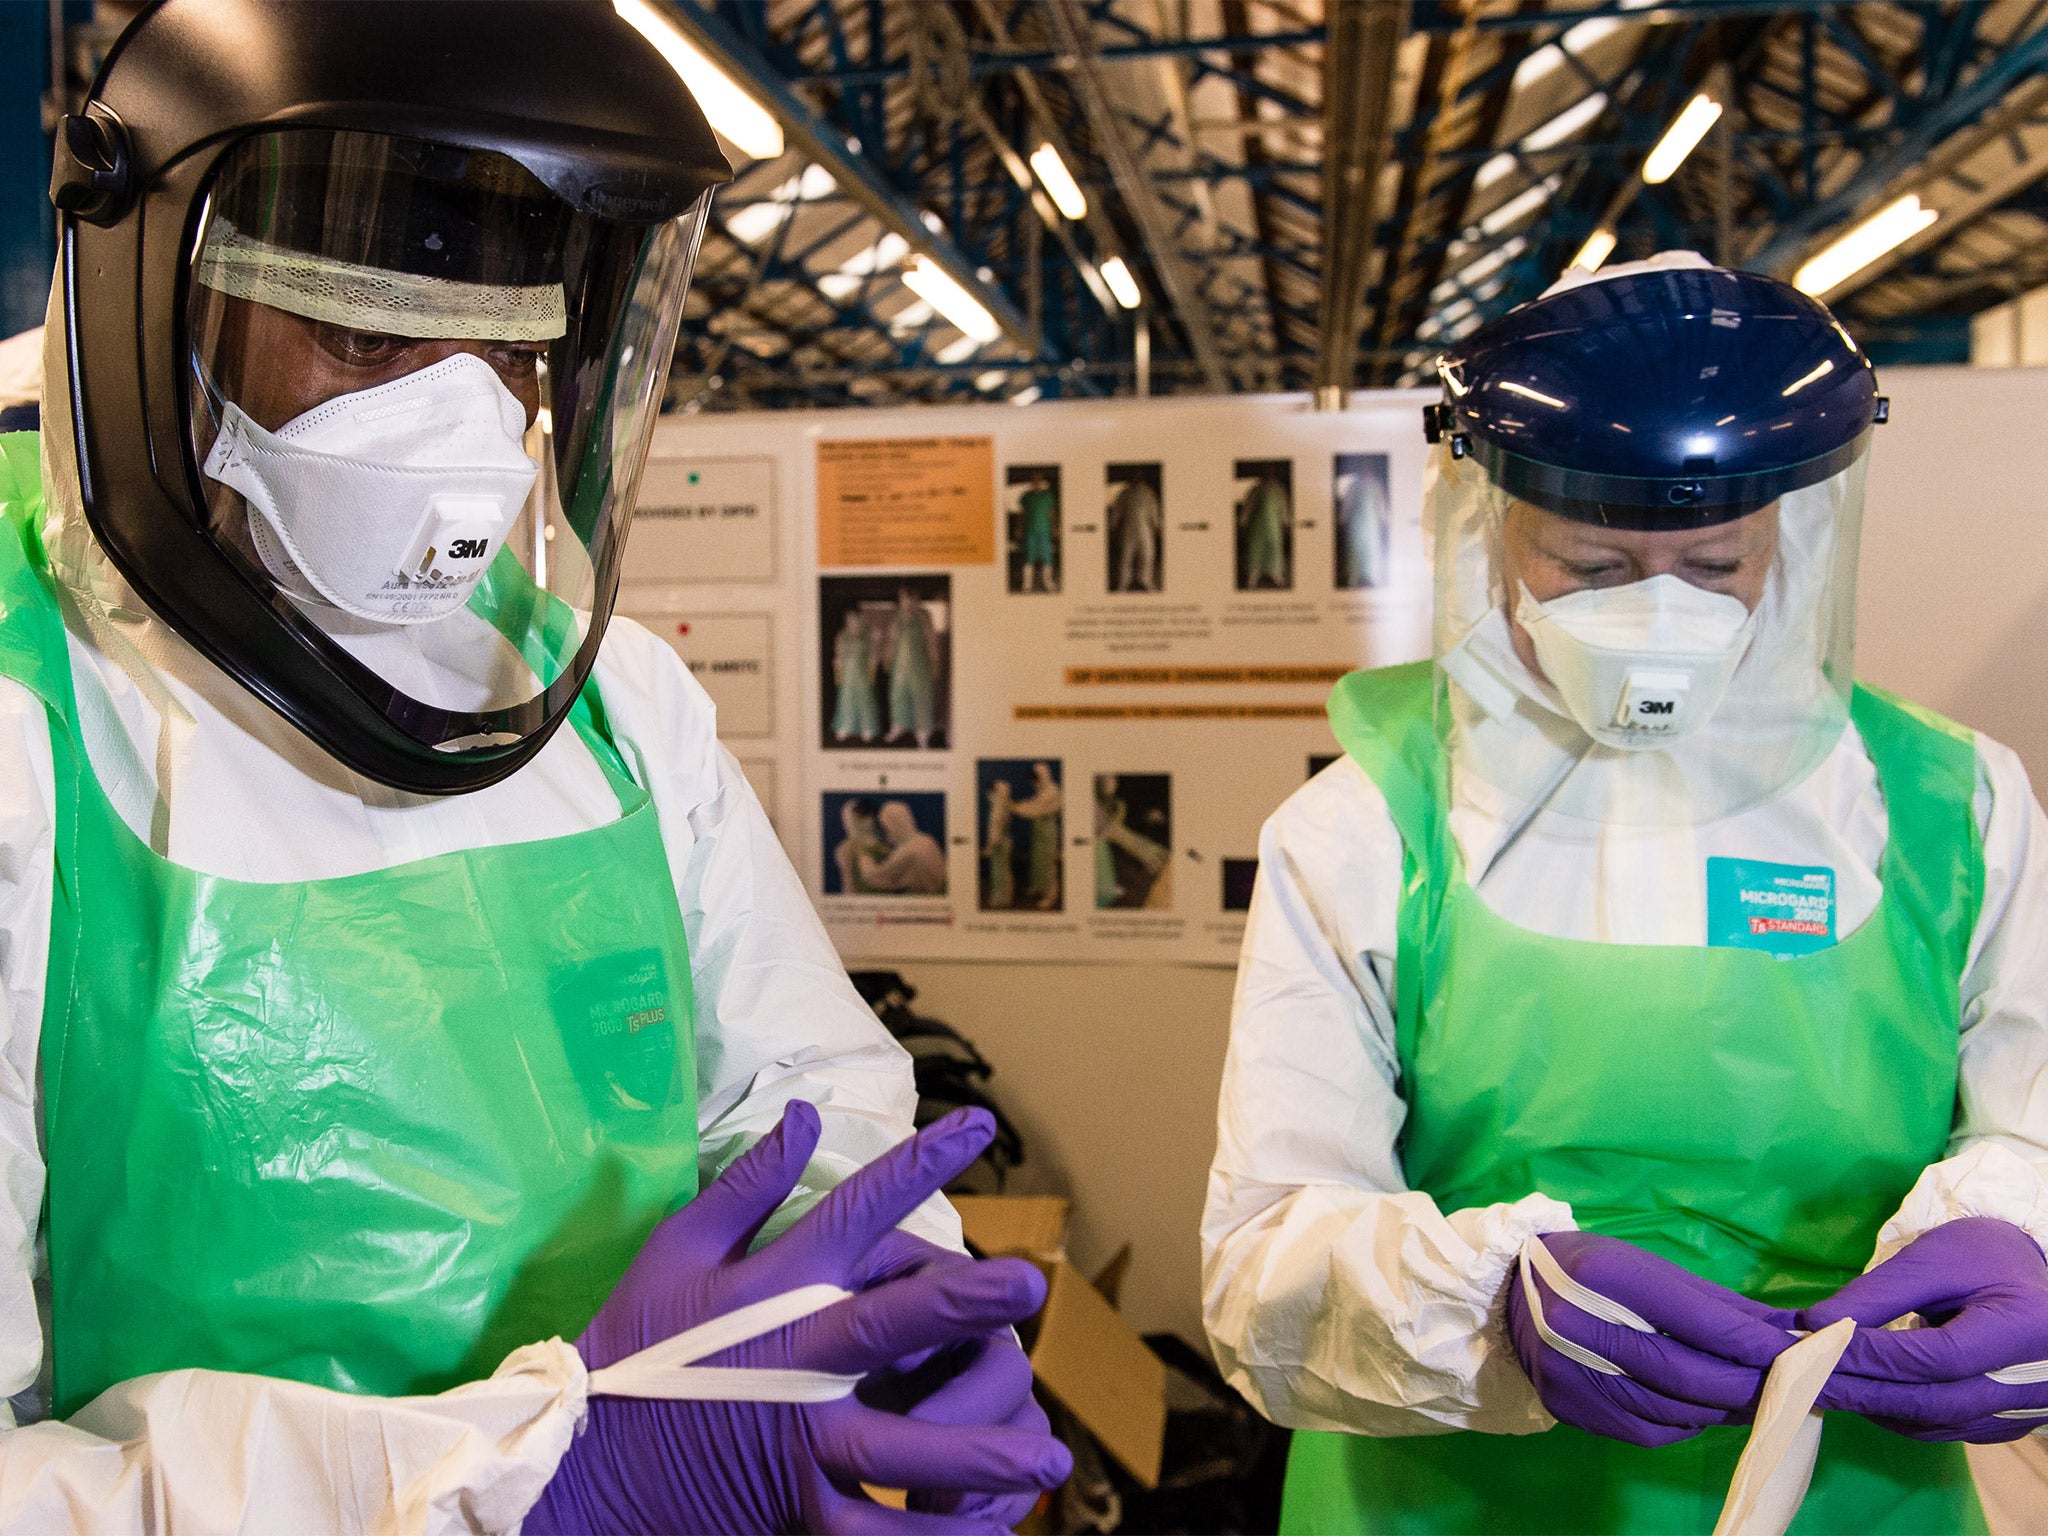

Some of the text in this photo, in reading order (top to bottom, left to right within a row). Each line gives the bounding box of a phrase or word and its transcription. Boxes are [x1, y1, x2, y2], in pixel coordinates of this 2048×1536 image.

[448, 538, 489, 559] 3M
[1639, 700, 1674, 714] 3M
[1740, 889, 1829, 910] MICROGARD
[640, 1009, 665, 1025] PLUS
